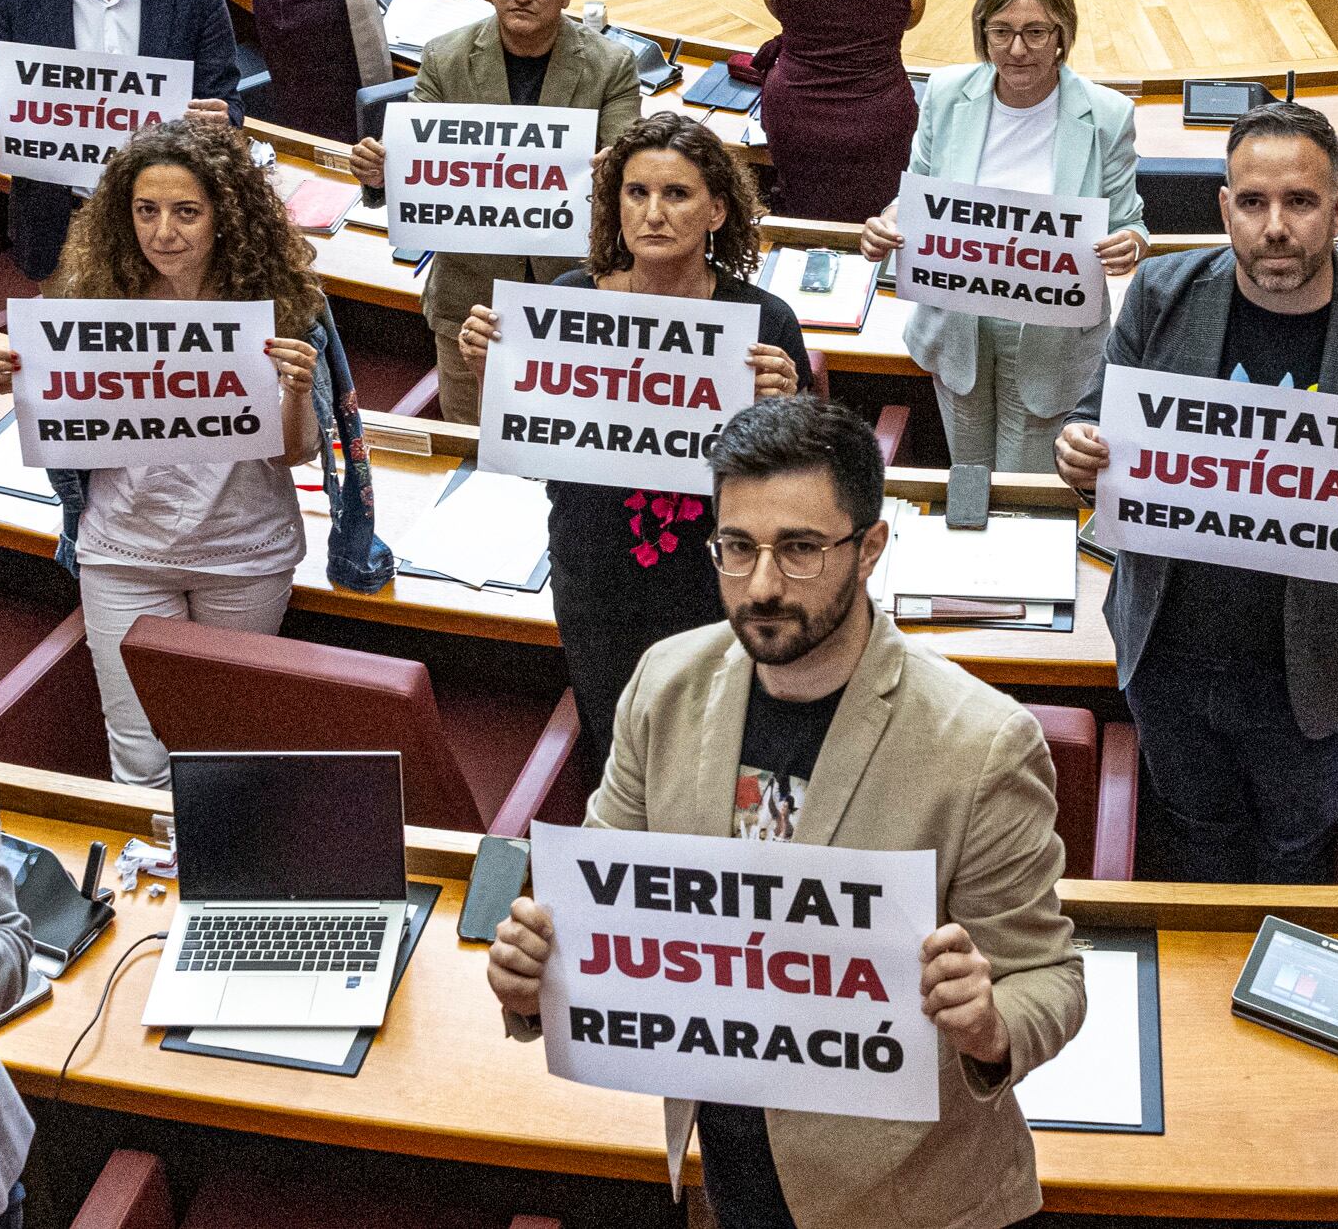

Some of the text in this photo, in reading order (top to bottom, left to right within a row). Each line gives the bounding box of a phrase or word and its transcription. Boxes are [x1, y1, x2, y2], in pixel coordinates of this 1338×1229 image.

[16, 61, 167, 96] VERITAT
[410, 118, 569, 149] VERITAT
[405, 153, 567, 190] JUSTÍCIA
[400, 200, 573, 229] REPARACIÓ
[925, 194, 1082, 238] VERITAT
[919, 235, 1079, 275] JUSTÍCIA
[912, 267, 1086, 307] REPARACIÓ
[41, 321, 240, 352] VERITAT
[524, 307, 723, 356] VERITAT
[42, 360, 247, 401] JUSTÍCIA
[516, 358, 720, 410] JUSTÍCIA
[38, 405, 261, 441] REPARACIÓ
[578, 860, 883, 929] VERITAT
[581, 932, 888, 1001] JUSTÍCIA
[569, 1006, 904, 1074] REPARACIÓ
